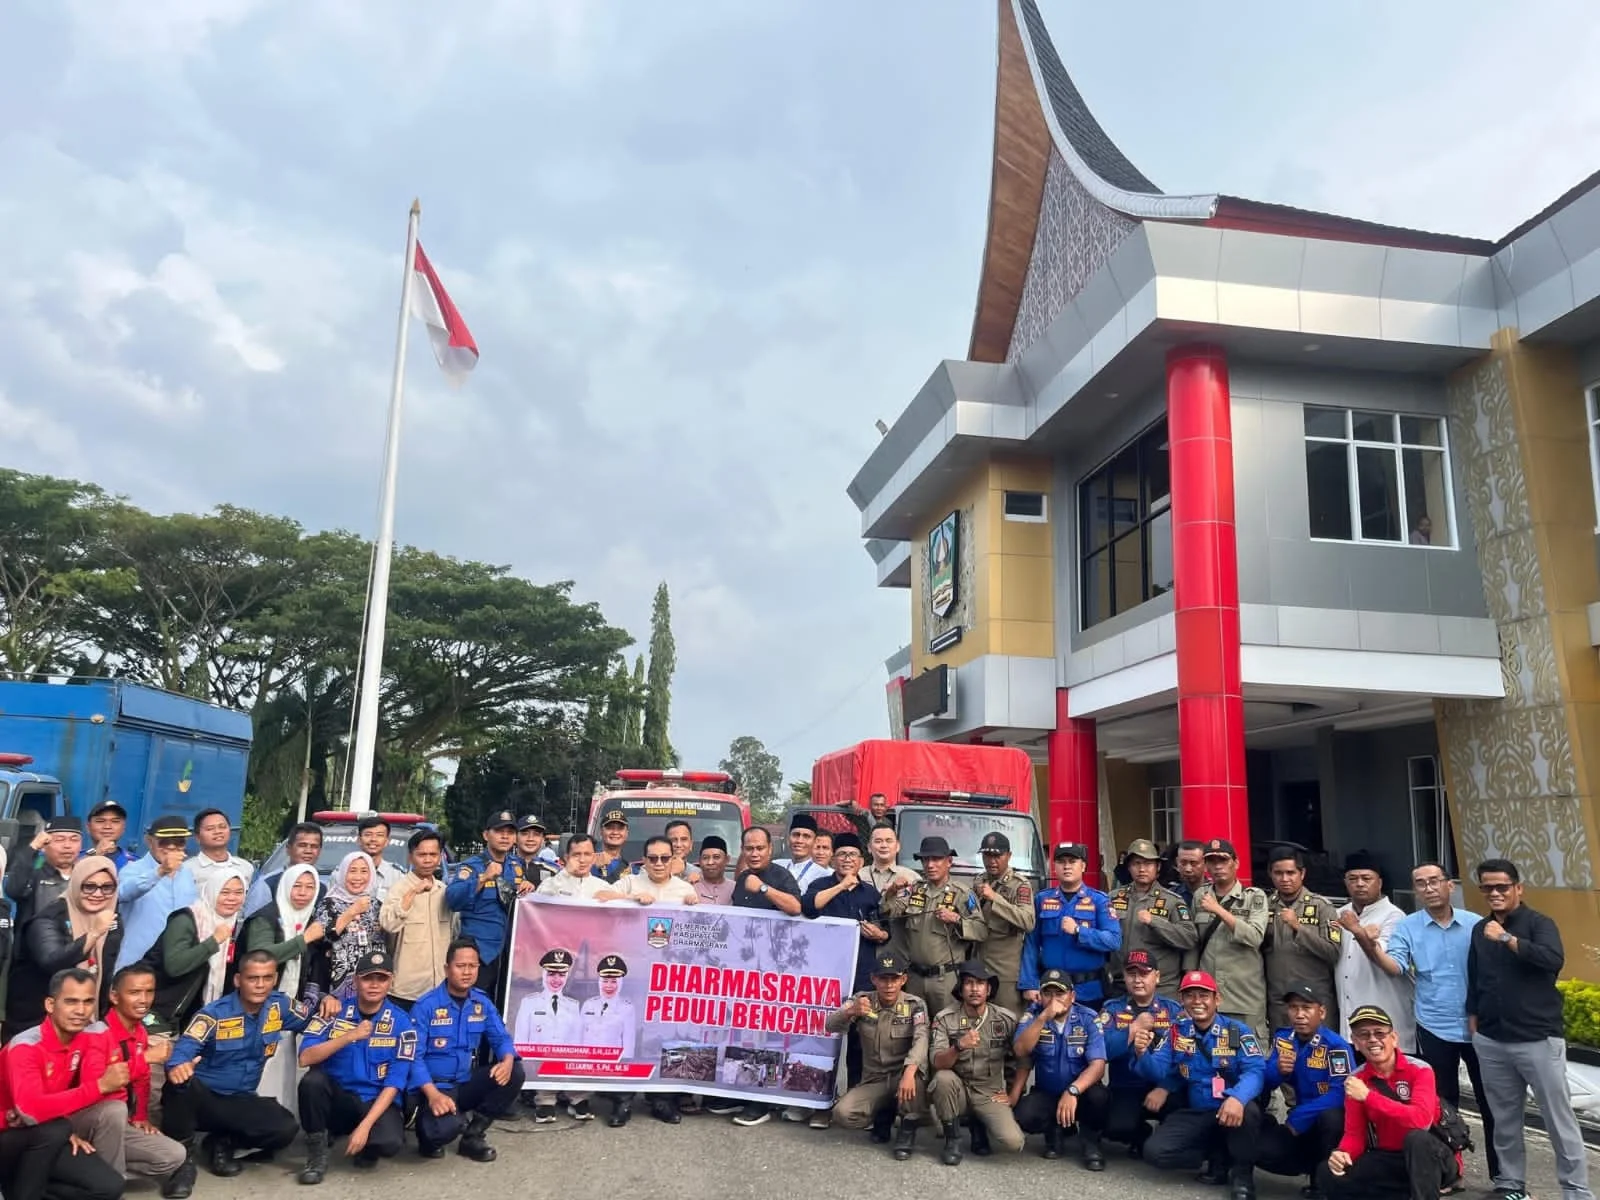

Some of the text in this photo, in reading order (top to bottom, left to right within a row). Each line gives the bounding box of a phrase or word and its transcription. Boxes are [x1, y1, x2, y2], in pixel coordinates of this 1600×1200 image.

[674, 922, 721, 932] PEMERINTAH
[673, 939, 728, 950] DHARMASRAYA
[649, 962, 843, 1009] DHARMASRAYA
[644, 995, 833, 1038] PEDULI BENCAN
